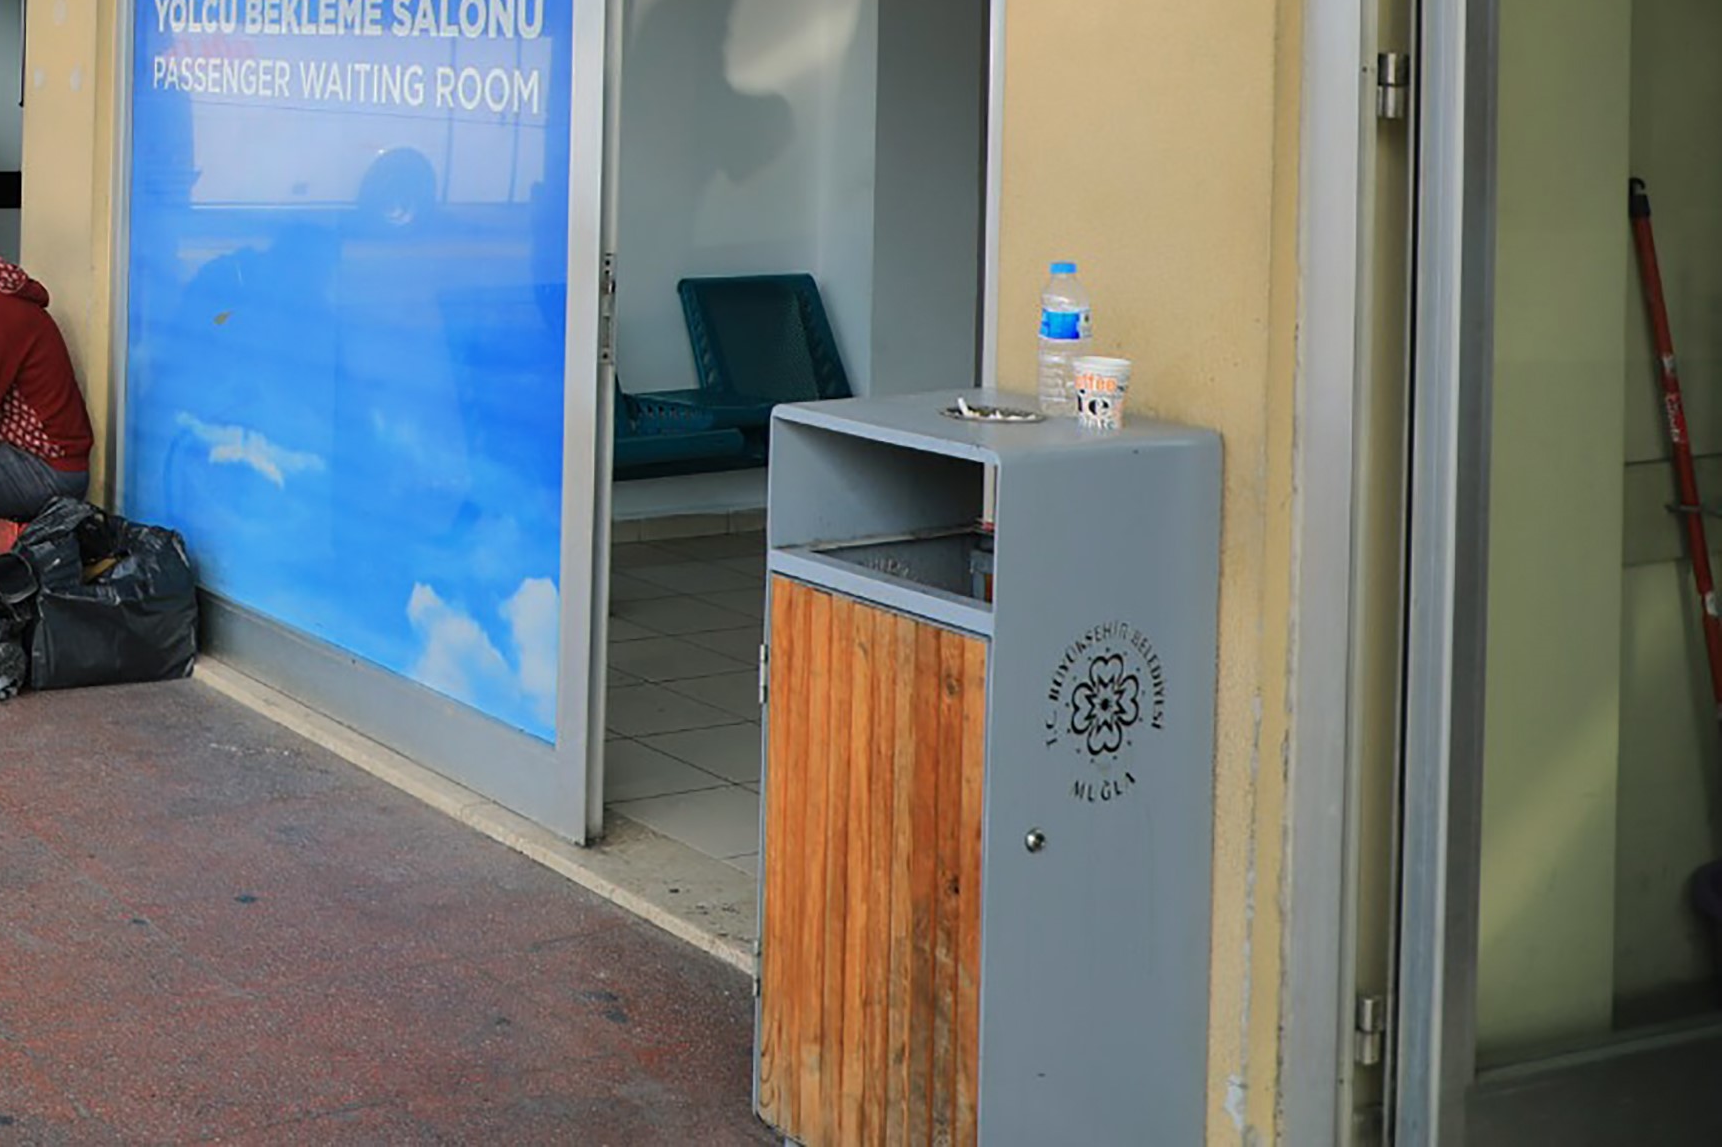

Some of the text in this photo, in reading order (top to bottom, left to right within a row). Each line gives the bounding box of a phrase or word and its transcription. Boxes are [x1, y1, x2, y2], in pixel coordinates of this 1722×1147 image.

[153, 57, 540, 116] PASSENGER WAITING ROOM
